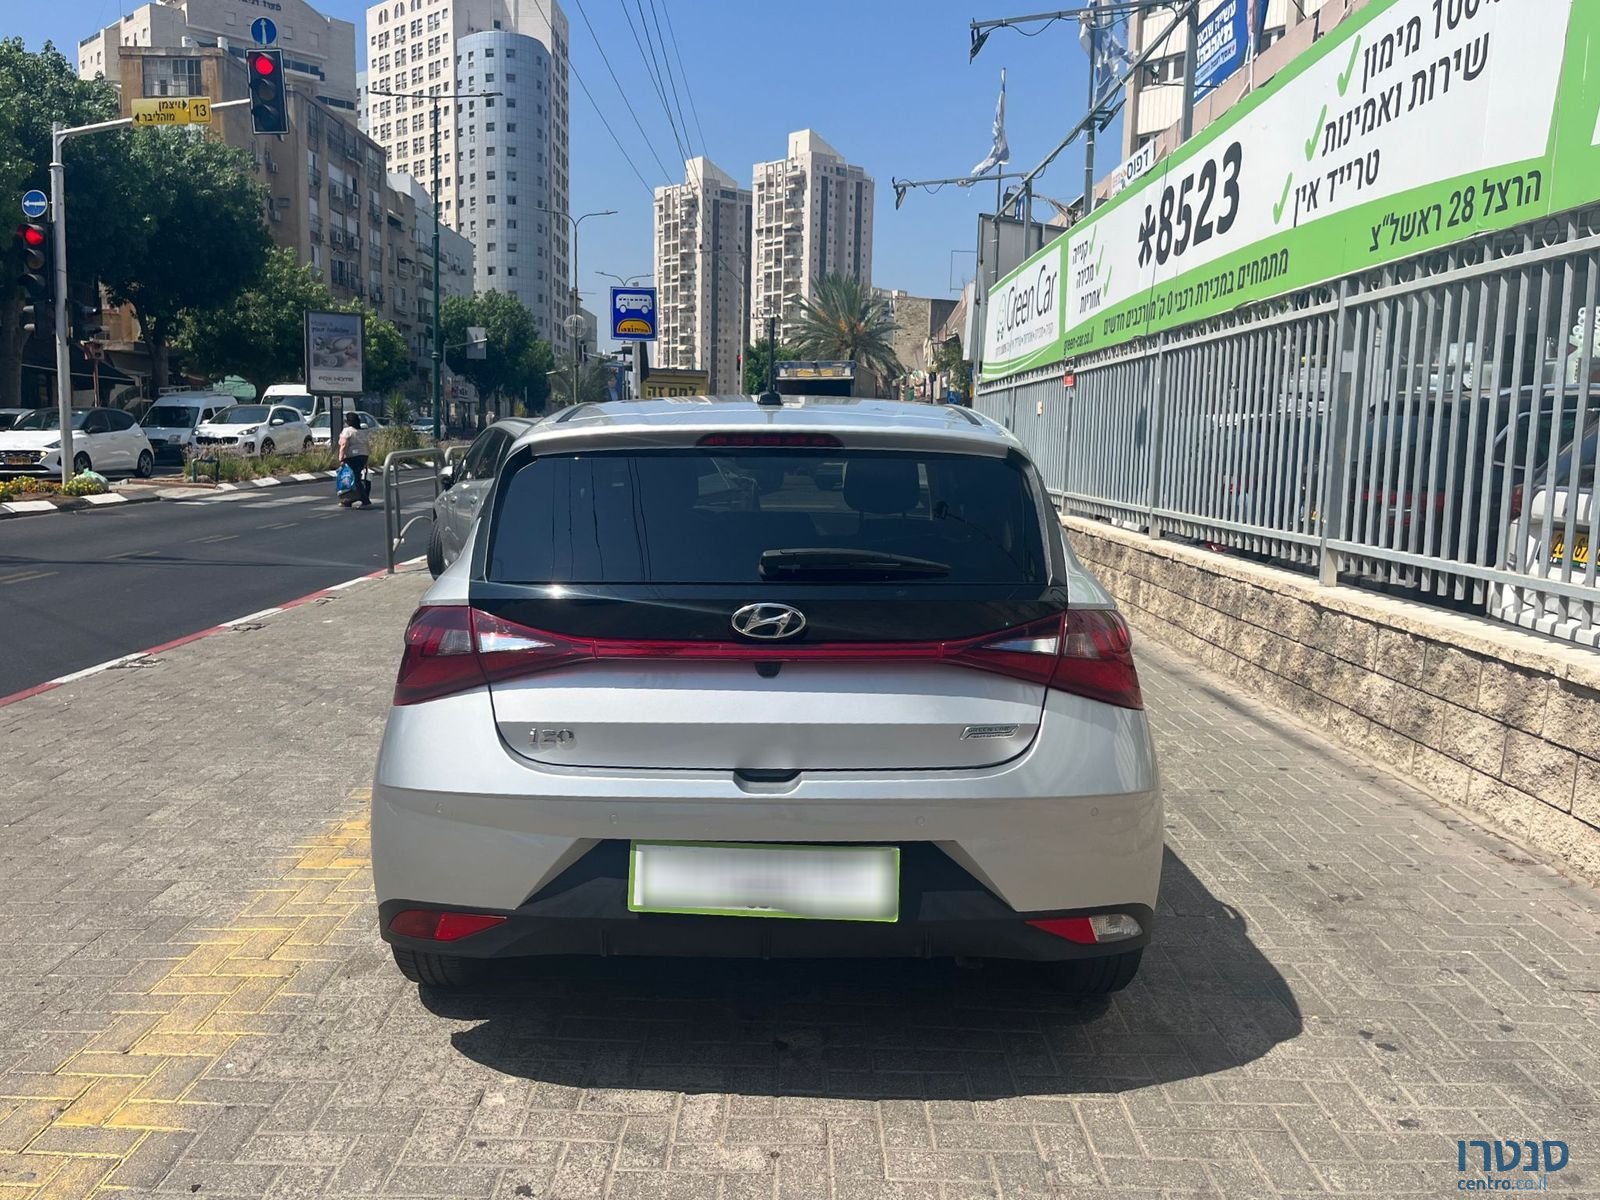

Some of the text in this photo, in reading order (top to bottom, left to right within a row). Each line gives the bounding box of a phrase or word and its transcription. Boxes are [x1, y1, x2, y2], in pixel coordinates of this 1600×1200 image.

[1362, 15, 1421, 94] מימון
[1407, 31, 1490, 113] שירות
[142, 110, 175, 121] מוהליבר
[159, 100, 181, 112] ויצמן
[193, 104, 207, 117] 13
[1321, 82, 1403, 157] ואמינות
[1126, 148, 1149, 180] דפוס
[1293, 148, 1380, 228] טרייד אין
[1481, 169, 1542, 217] הרצל
[1447, 185, 1476, 228] 28
[1072, 240, 1089, 265] קנייה
[1237, 247, 1289, 290] מתמחים
[1036, 264, 1058, 317] Car
[1076, 263, 1094, 289] מכירה
[1197, 270, 1234, 305] במכירת
[1079, 287, 1102, 314] אחריות
[1174, 287, 1194, 314] רכבי
[1103, 312, 1125, 336] חדשים
